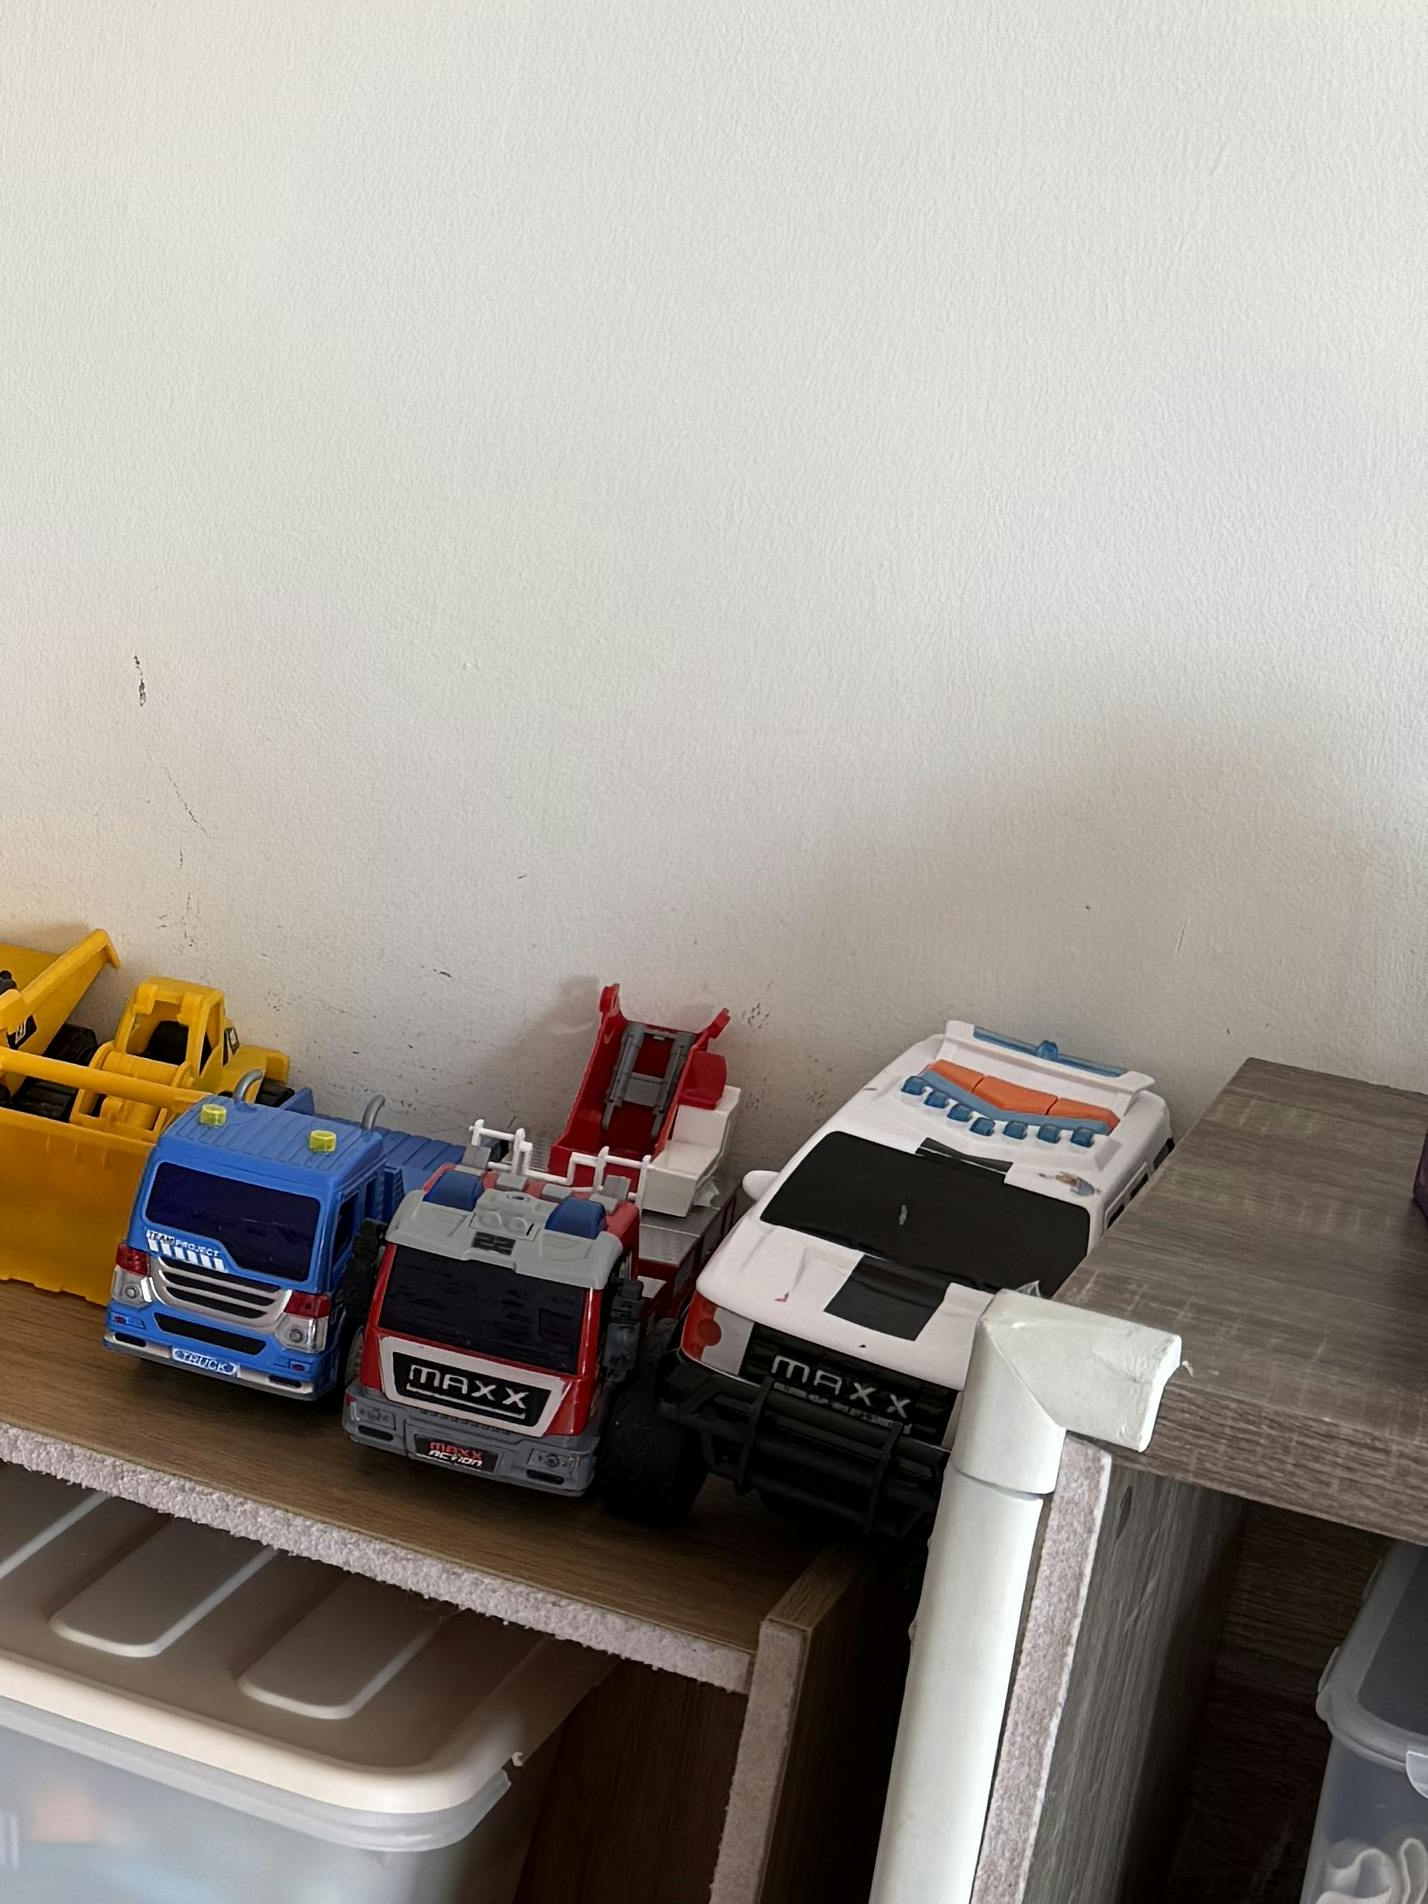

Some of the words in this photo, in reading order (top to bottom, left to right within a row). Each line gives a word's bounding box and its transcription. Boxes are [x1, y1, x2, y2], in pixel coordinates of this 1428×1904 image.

[175, 1239, 221, 1257] PROJECT
[408, 1364, 531, 1409] MAXX
[770, 1354, 911, 1419] MAXX
[429, 1441, 483, 1460] MAXX
